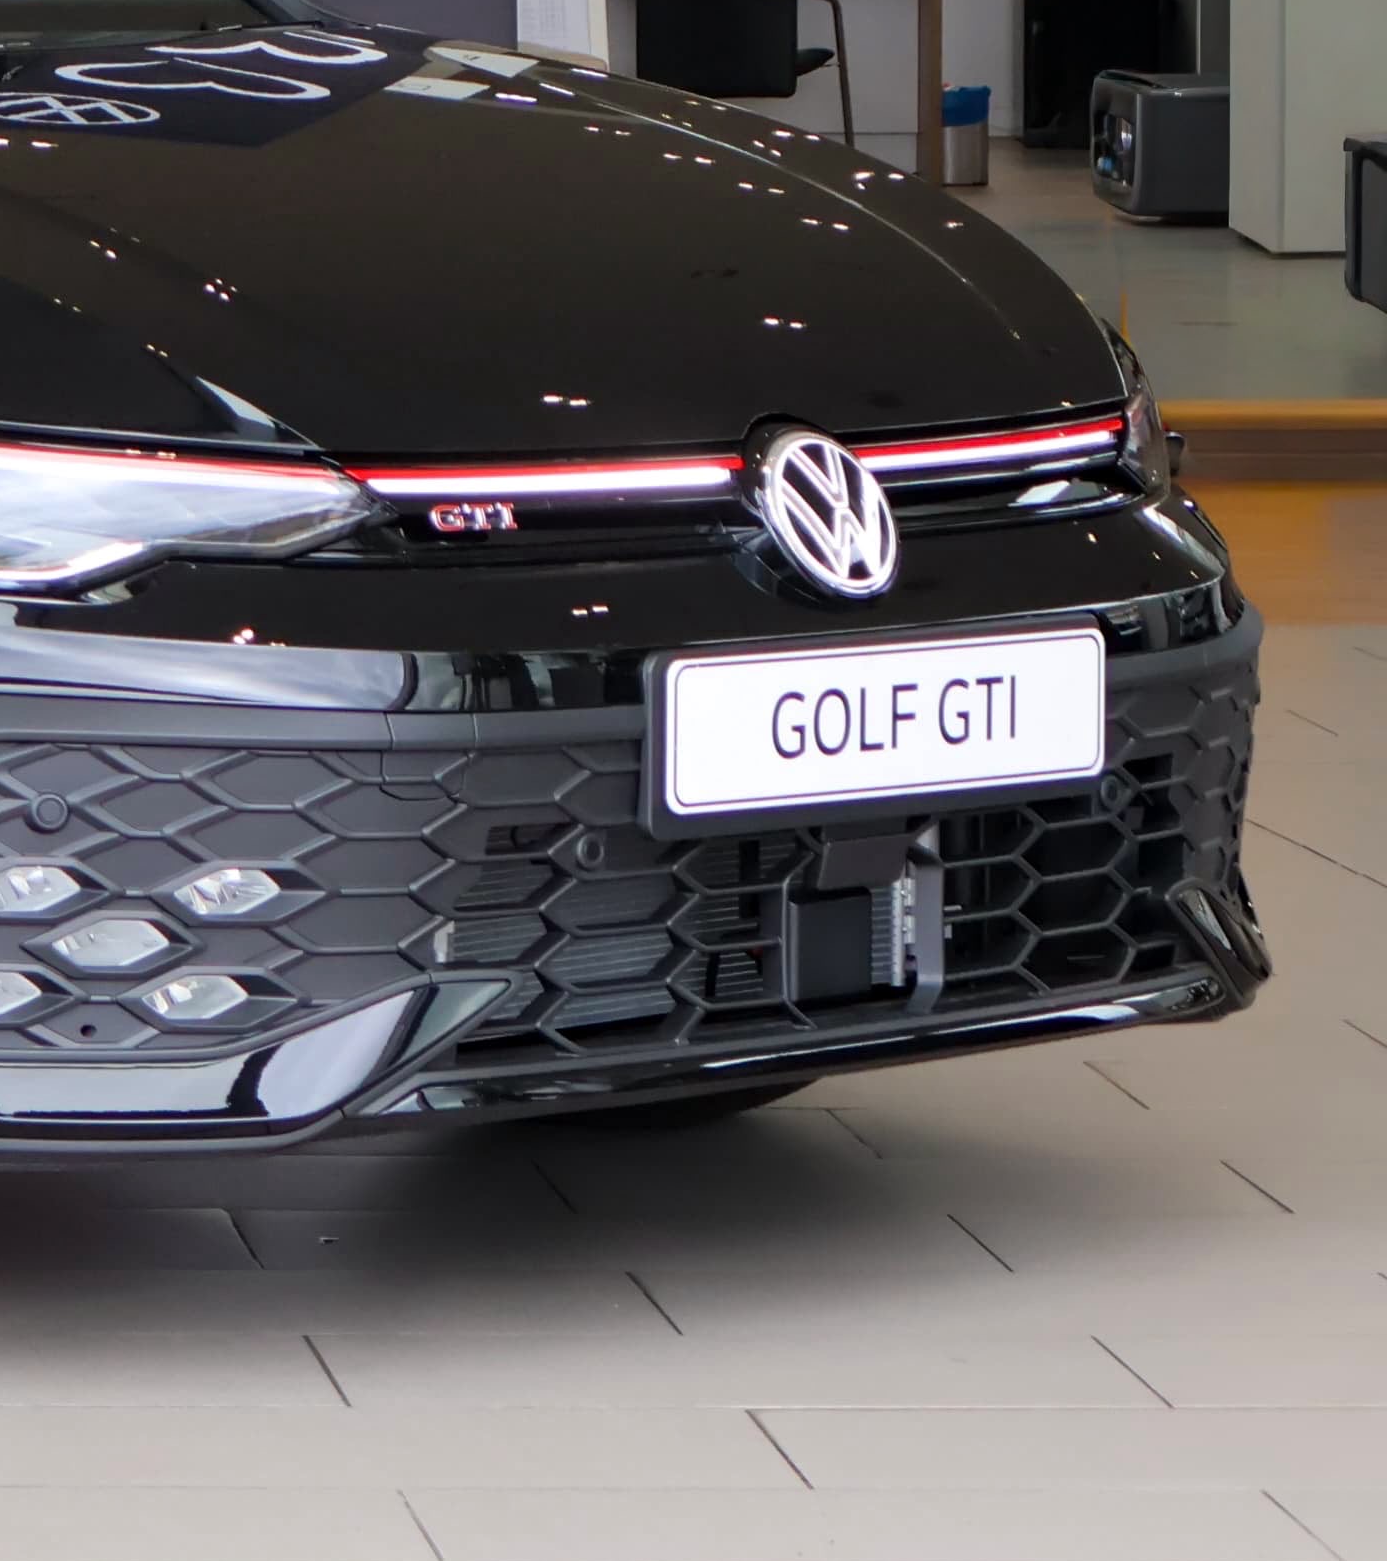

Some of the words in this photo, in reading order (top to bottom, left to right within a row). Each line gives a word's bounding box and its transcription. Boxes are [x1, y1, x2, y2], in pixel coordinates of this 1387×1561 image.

[429, 501, 519, 533] GTI
[771, 682, 918, 760] GOLF
[938, 675, 1017, 746] GTI
